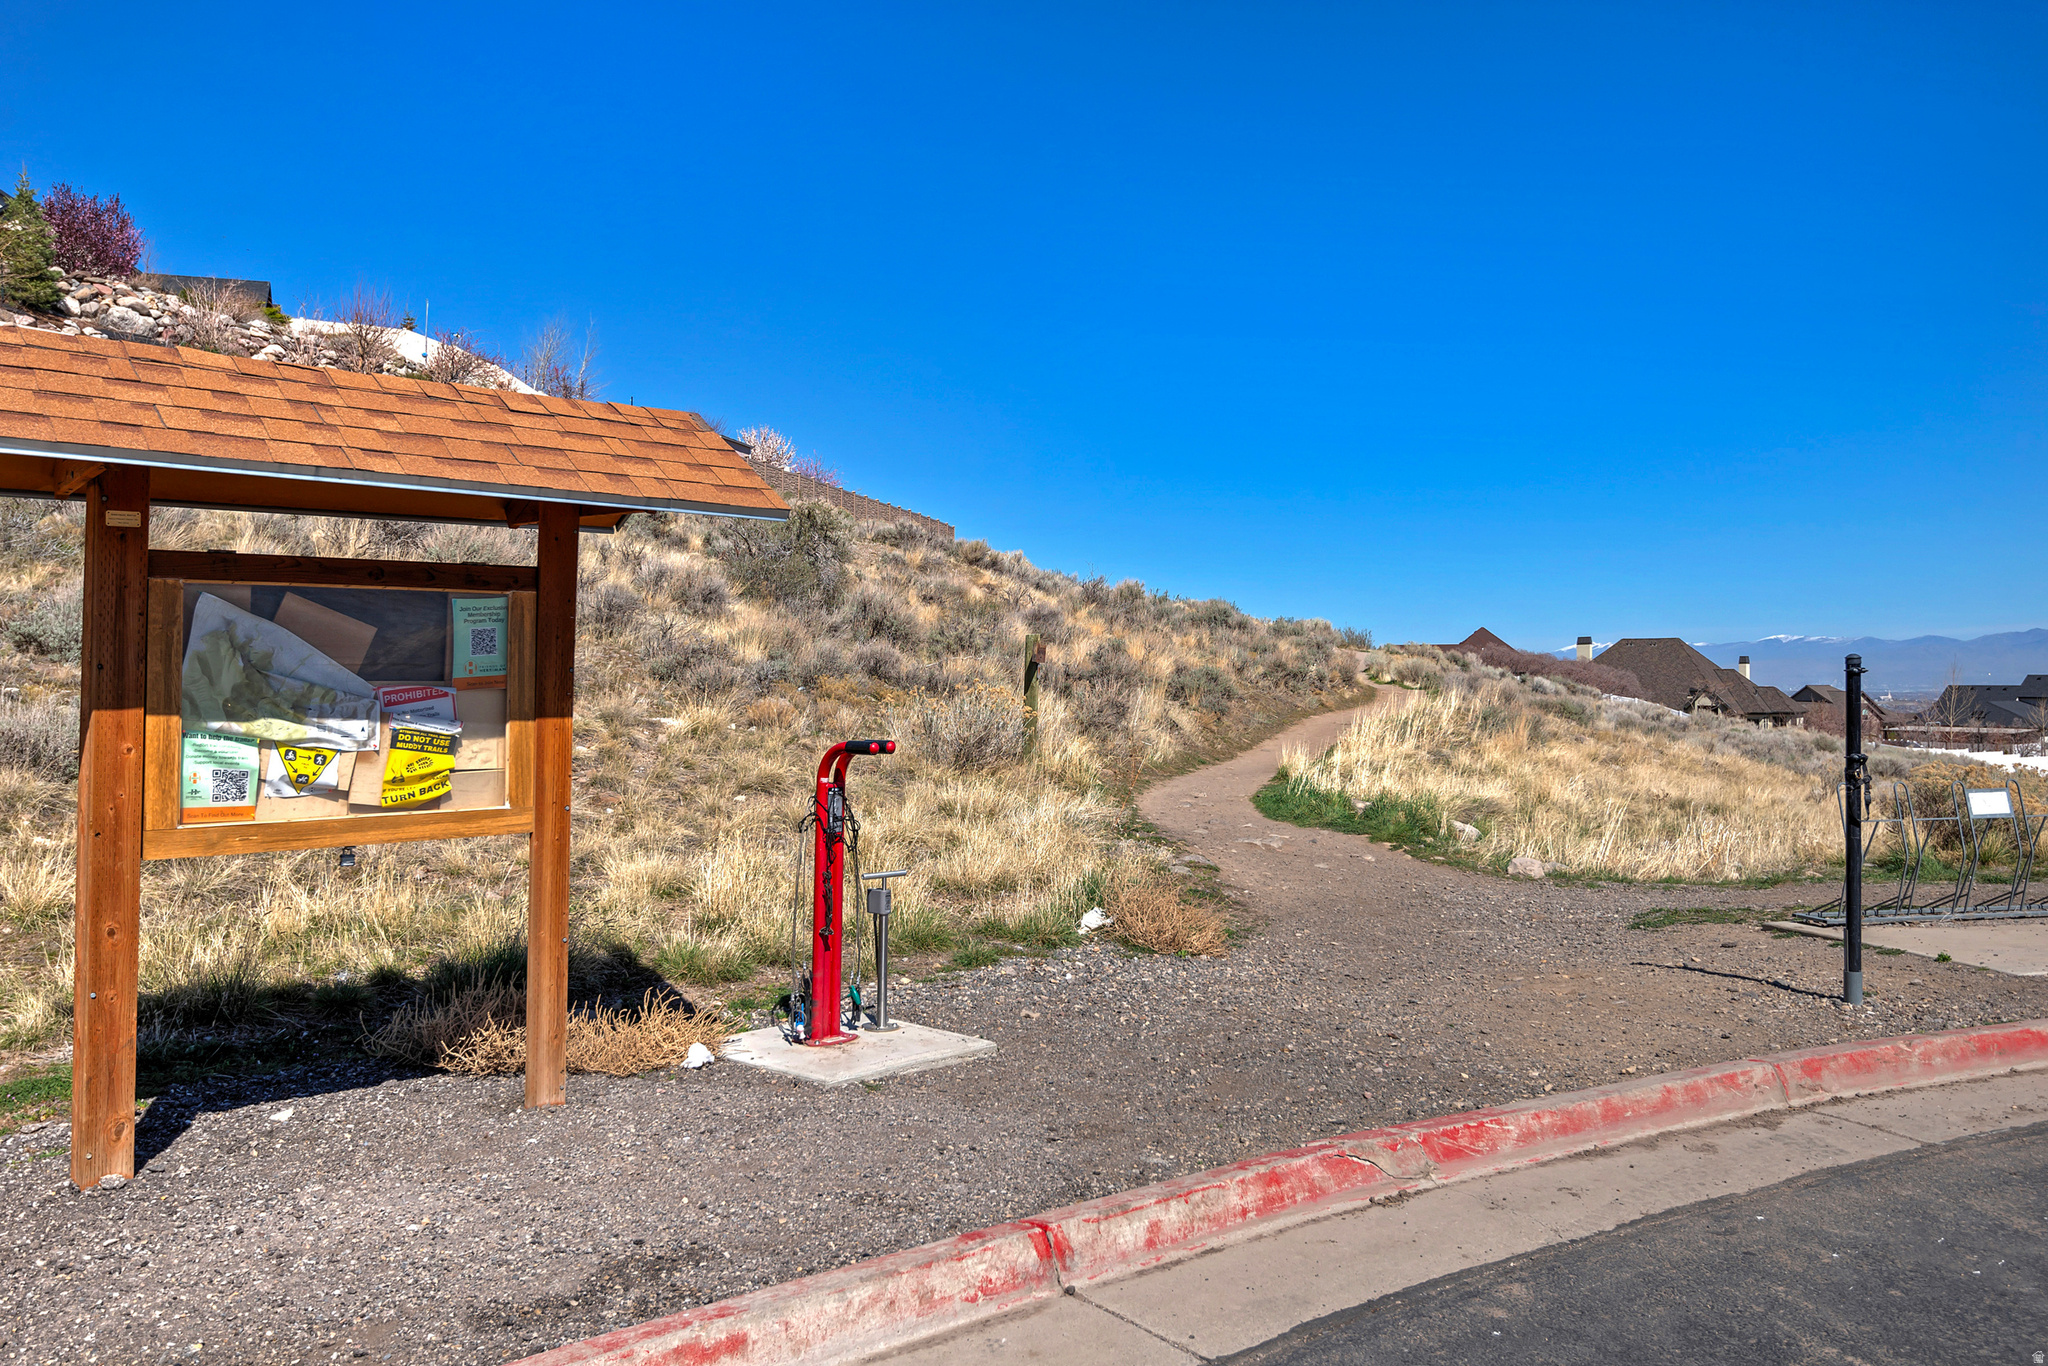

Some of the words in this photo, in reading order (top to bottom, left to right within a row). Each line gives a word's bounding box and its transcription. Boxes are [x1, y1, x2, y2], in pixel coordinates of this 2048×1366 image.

[384, 690, 445, 704] PROHIBITED
[396, 742, 422, 750] MUDDY
[423, 745, 448, 753] TRAILS
[382, 791, 416, 804] TURN
[419, 780, 449, 795] BACK
